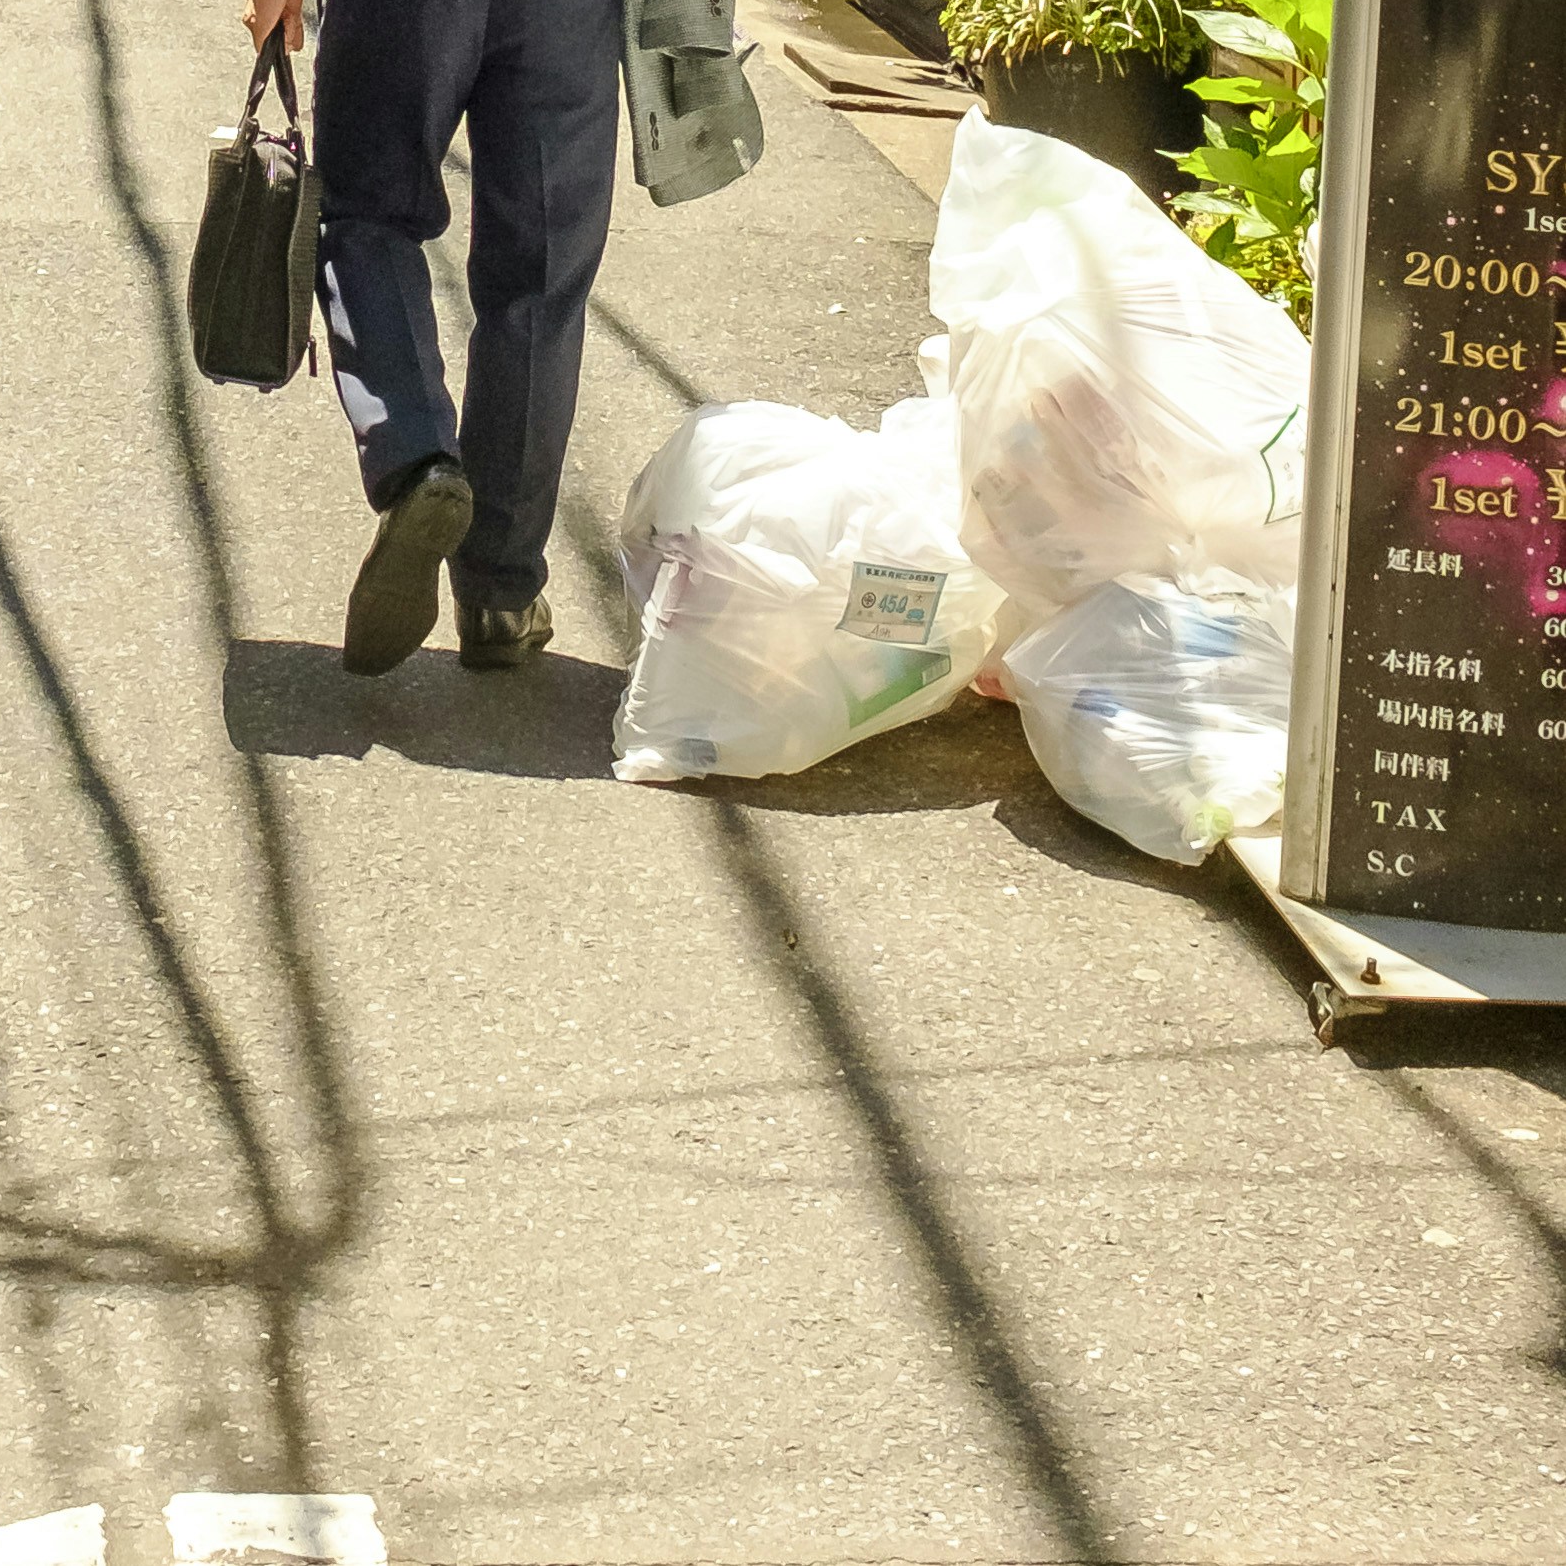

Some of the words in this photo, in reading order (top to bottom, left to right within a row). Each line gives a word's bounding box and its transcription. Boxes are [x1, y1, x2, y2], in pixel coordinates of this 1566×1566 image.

[1485, 148, 1566, 196] SY
[1438, 330, 1528, 371] 1set
[1429, 476, 1518, 519] 1set
[1386, 546, 1463, 578] 延長料
[1380, 648, 1483, 683] 本指名料
[1377, 698, 1506, 737] 場内指名料
[1374, 749, 1451, 782] 同伴料
[1371, 800, 1447, 832] TAX
[1367, 849, 1416, 878] S.C
